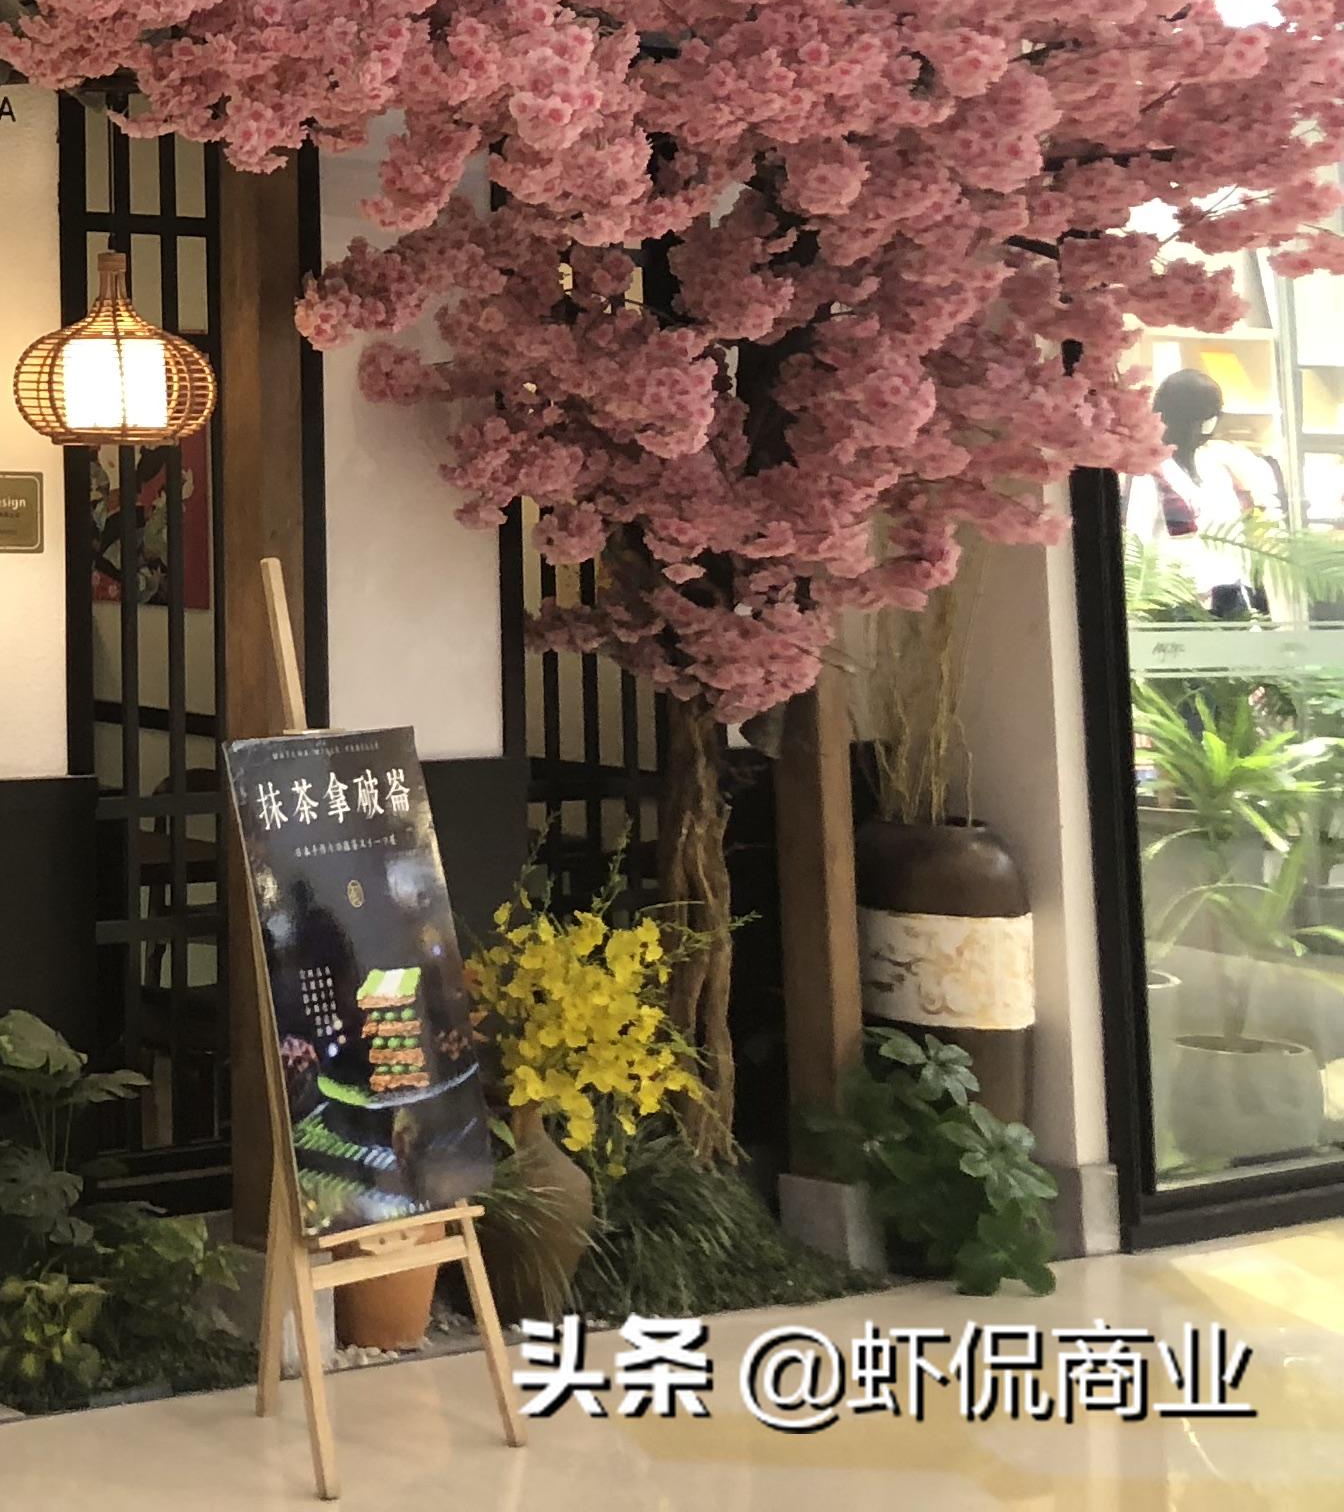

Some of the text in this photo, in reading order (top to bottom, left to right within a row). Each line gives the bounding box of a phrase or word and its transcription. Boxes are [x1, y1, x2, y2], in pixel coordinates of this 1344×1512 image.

[256, 768, 411, 831] 抹茶拿破崙
